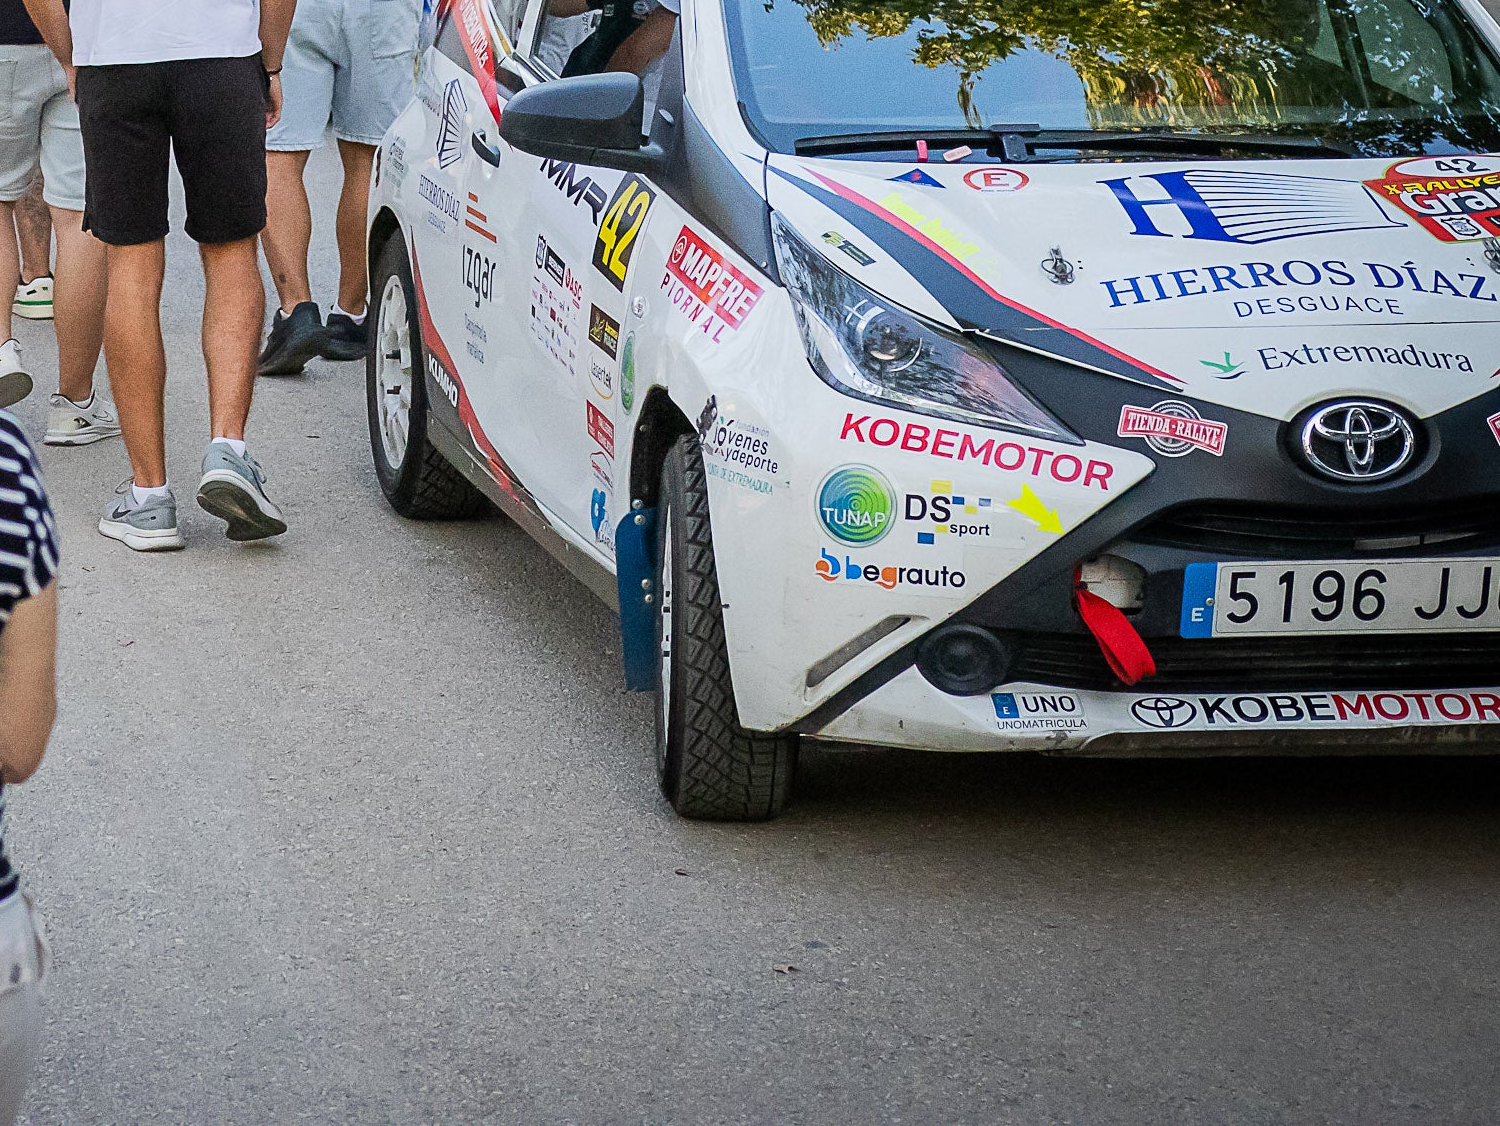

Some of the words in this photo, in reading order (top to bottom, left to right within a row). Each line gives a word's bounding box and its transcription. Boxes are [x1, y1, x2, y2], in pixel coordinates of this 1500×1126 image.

[983, 173, 1009, 186] E
[1435, 159, 1490, 173] 42
[419, 174, 445, 212] HIERROS
[1383, 184, 1402, 195] X
[1403, 175, 1500, 193] RALLYE
[598, 180, 650, 282] 42
[679, 242, 759, 321] MAPFRE
[1100, 260, 1356, 308] HIERROS
[1362, 260, 1498, 302] DÍAZ
[660, 272, 725, 344] PIORNAL
[1233, 295, 1404, 319] DESGUACE
[1258, 343, 1474, 373] Extremadura
[428, 353, 458, 408] KUMHO
[713, 419, 769, 455] jóvenes
[1127, 412, 1170, 434] TIENDA
[1175, 421, 1221, 448] RALLYE
[724, 447, 778, 474] ydeporte
[840, 413, 1115, 491] KOBEMOTOR
[728, 470, 773, 495] EXTREMADURA
[822, 506, 887, 528] TUNAP
[904, 493, 951, 523] DS
[949, 521, 991, 539] sport
[845, 555, 967, 590] begrauto
[1226, 569, 1388, 624] 5196
[1414, 566, 1500, 622] JJ
[1191, 607, 1205, 623] E
[1002, 706, 1011, 715] E
[1022, 695, 1076, 713] UNO
[1198, 691, 1500, 724] KOBEMOTOR
[997, 719, 1088, 731] UNOMATRICULA
